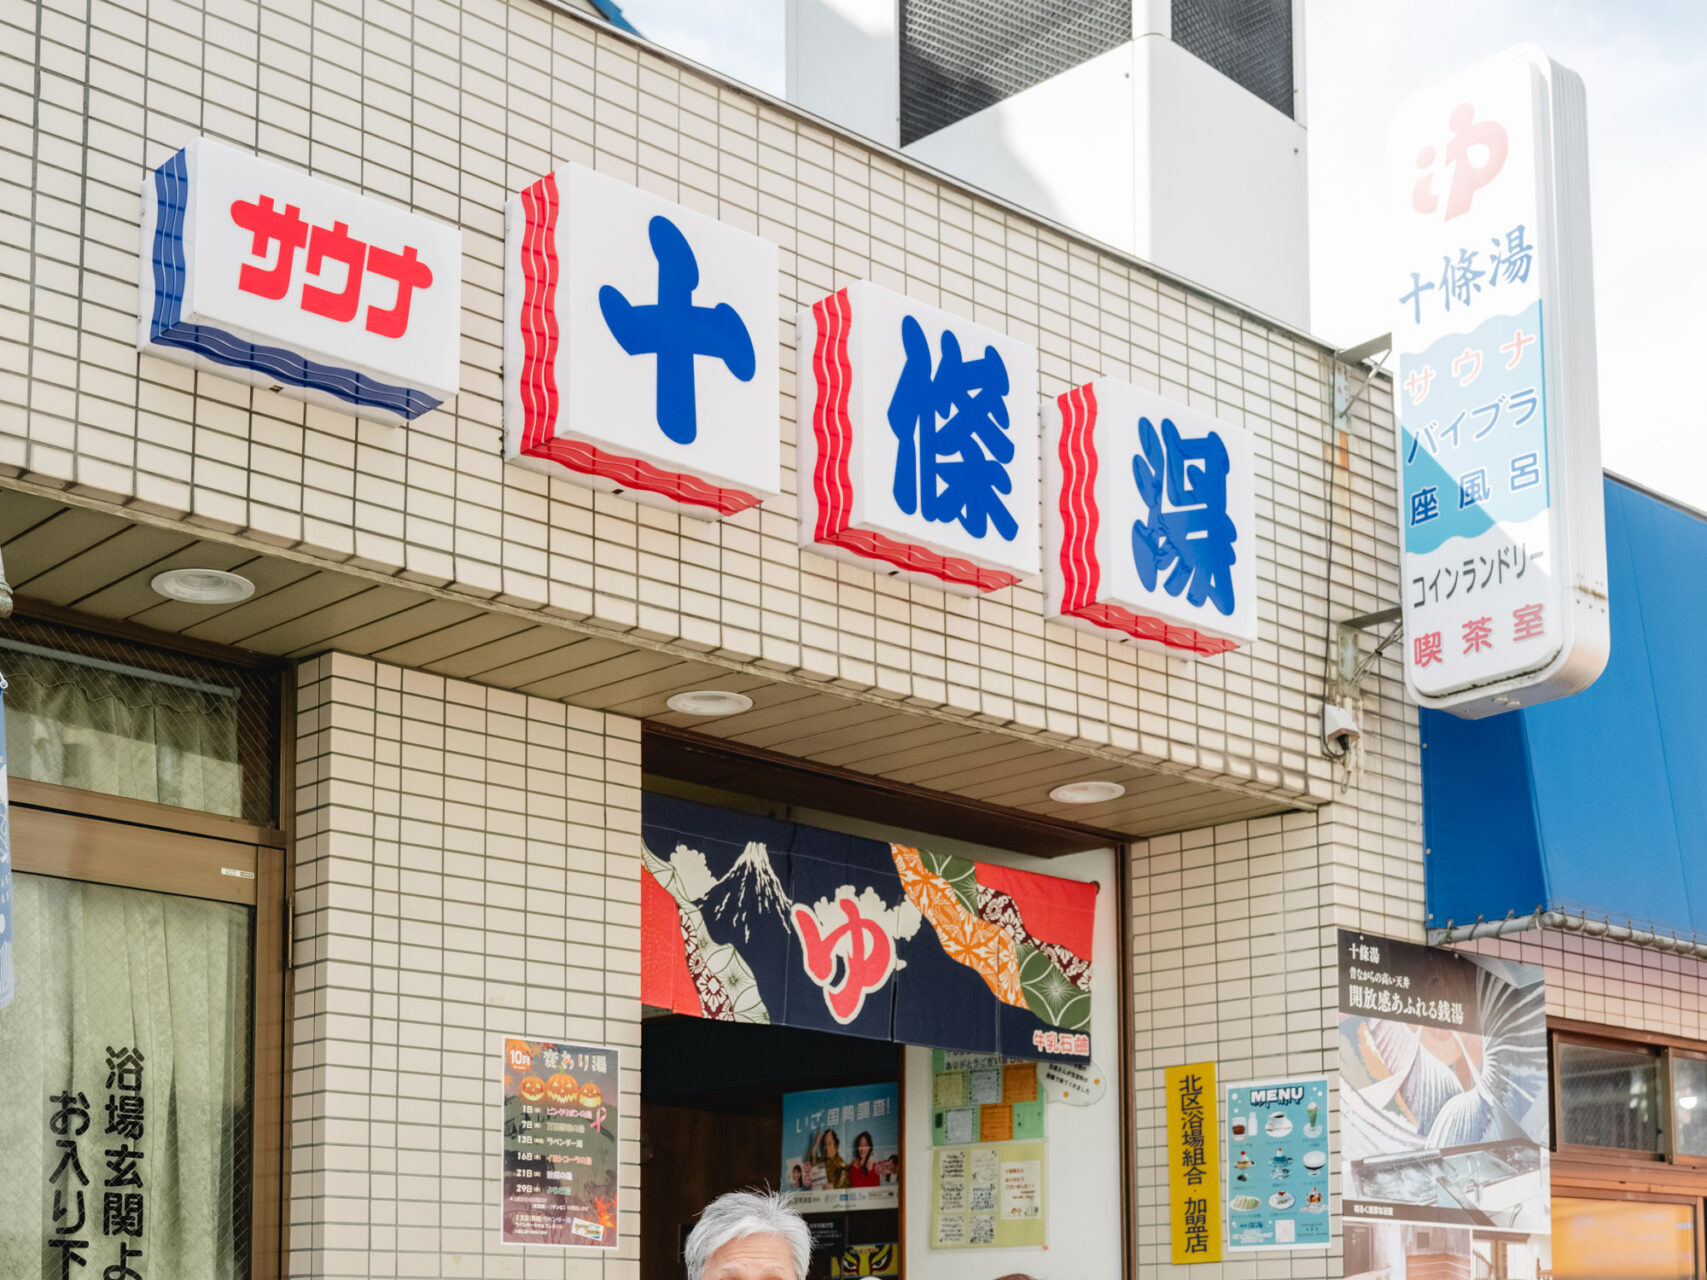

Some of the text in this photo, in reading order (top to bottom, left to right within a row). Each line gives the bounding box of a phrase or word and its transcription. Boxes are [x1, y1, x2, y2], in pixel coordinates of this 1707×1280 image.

[1411, 102, 1509, 222] ゆ
[230, 194, 434, 339] サウナ
[1399, 224, 1534, 325] 十條湯
[1404, 330, 1536, 406] サウナ
[1406, 387, 1538, 465] バイブラ
[1409, 452, 1541, 528] 座風呂
[1412, 543, 1544, 609] コインランドリー
[1413, 602, 1545, 669] 喫茶室
[793, 897, 893, 1020] ゆ
[1348, 942, 1380, 965] 十條湯
[1349, 966, 1410, 989] 昔ながらの高い天井
[1349, 984, 1464, 1025] 開放感あふれる銭湯
[509, 1049, 531, 1065] 10月
[543, 1049, 607, 1074] 変わり湯
[1250, 1087, 1304, 1106] MENU
